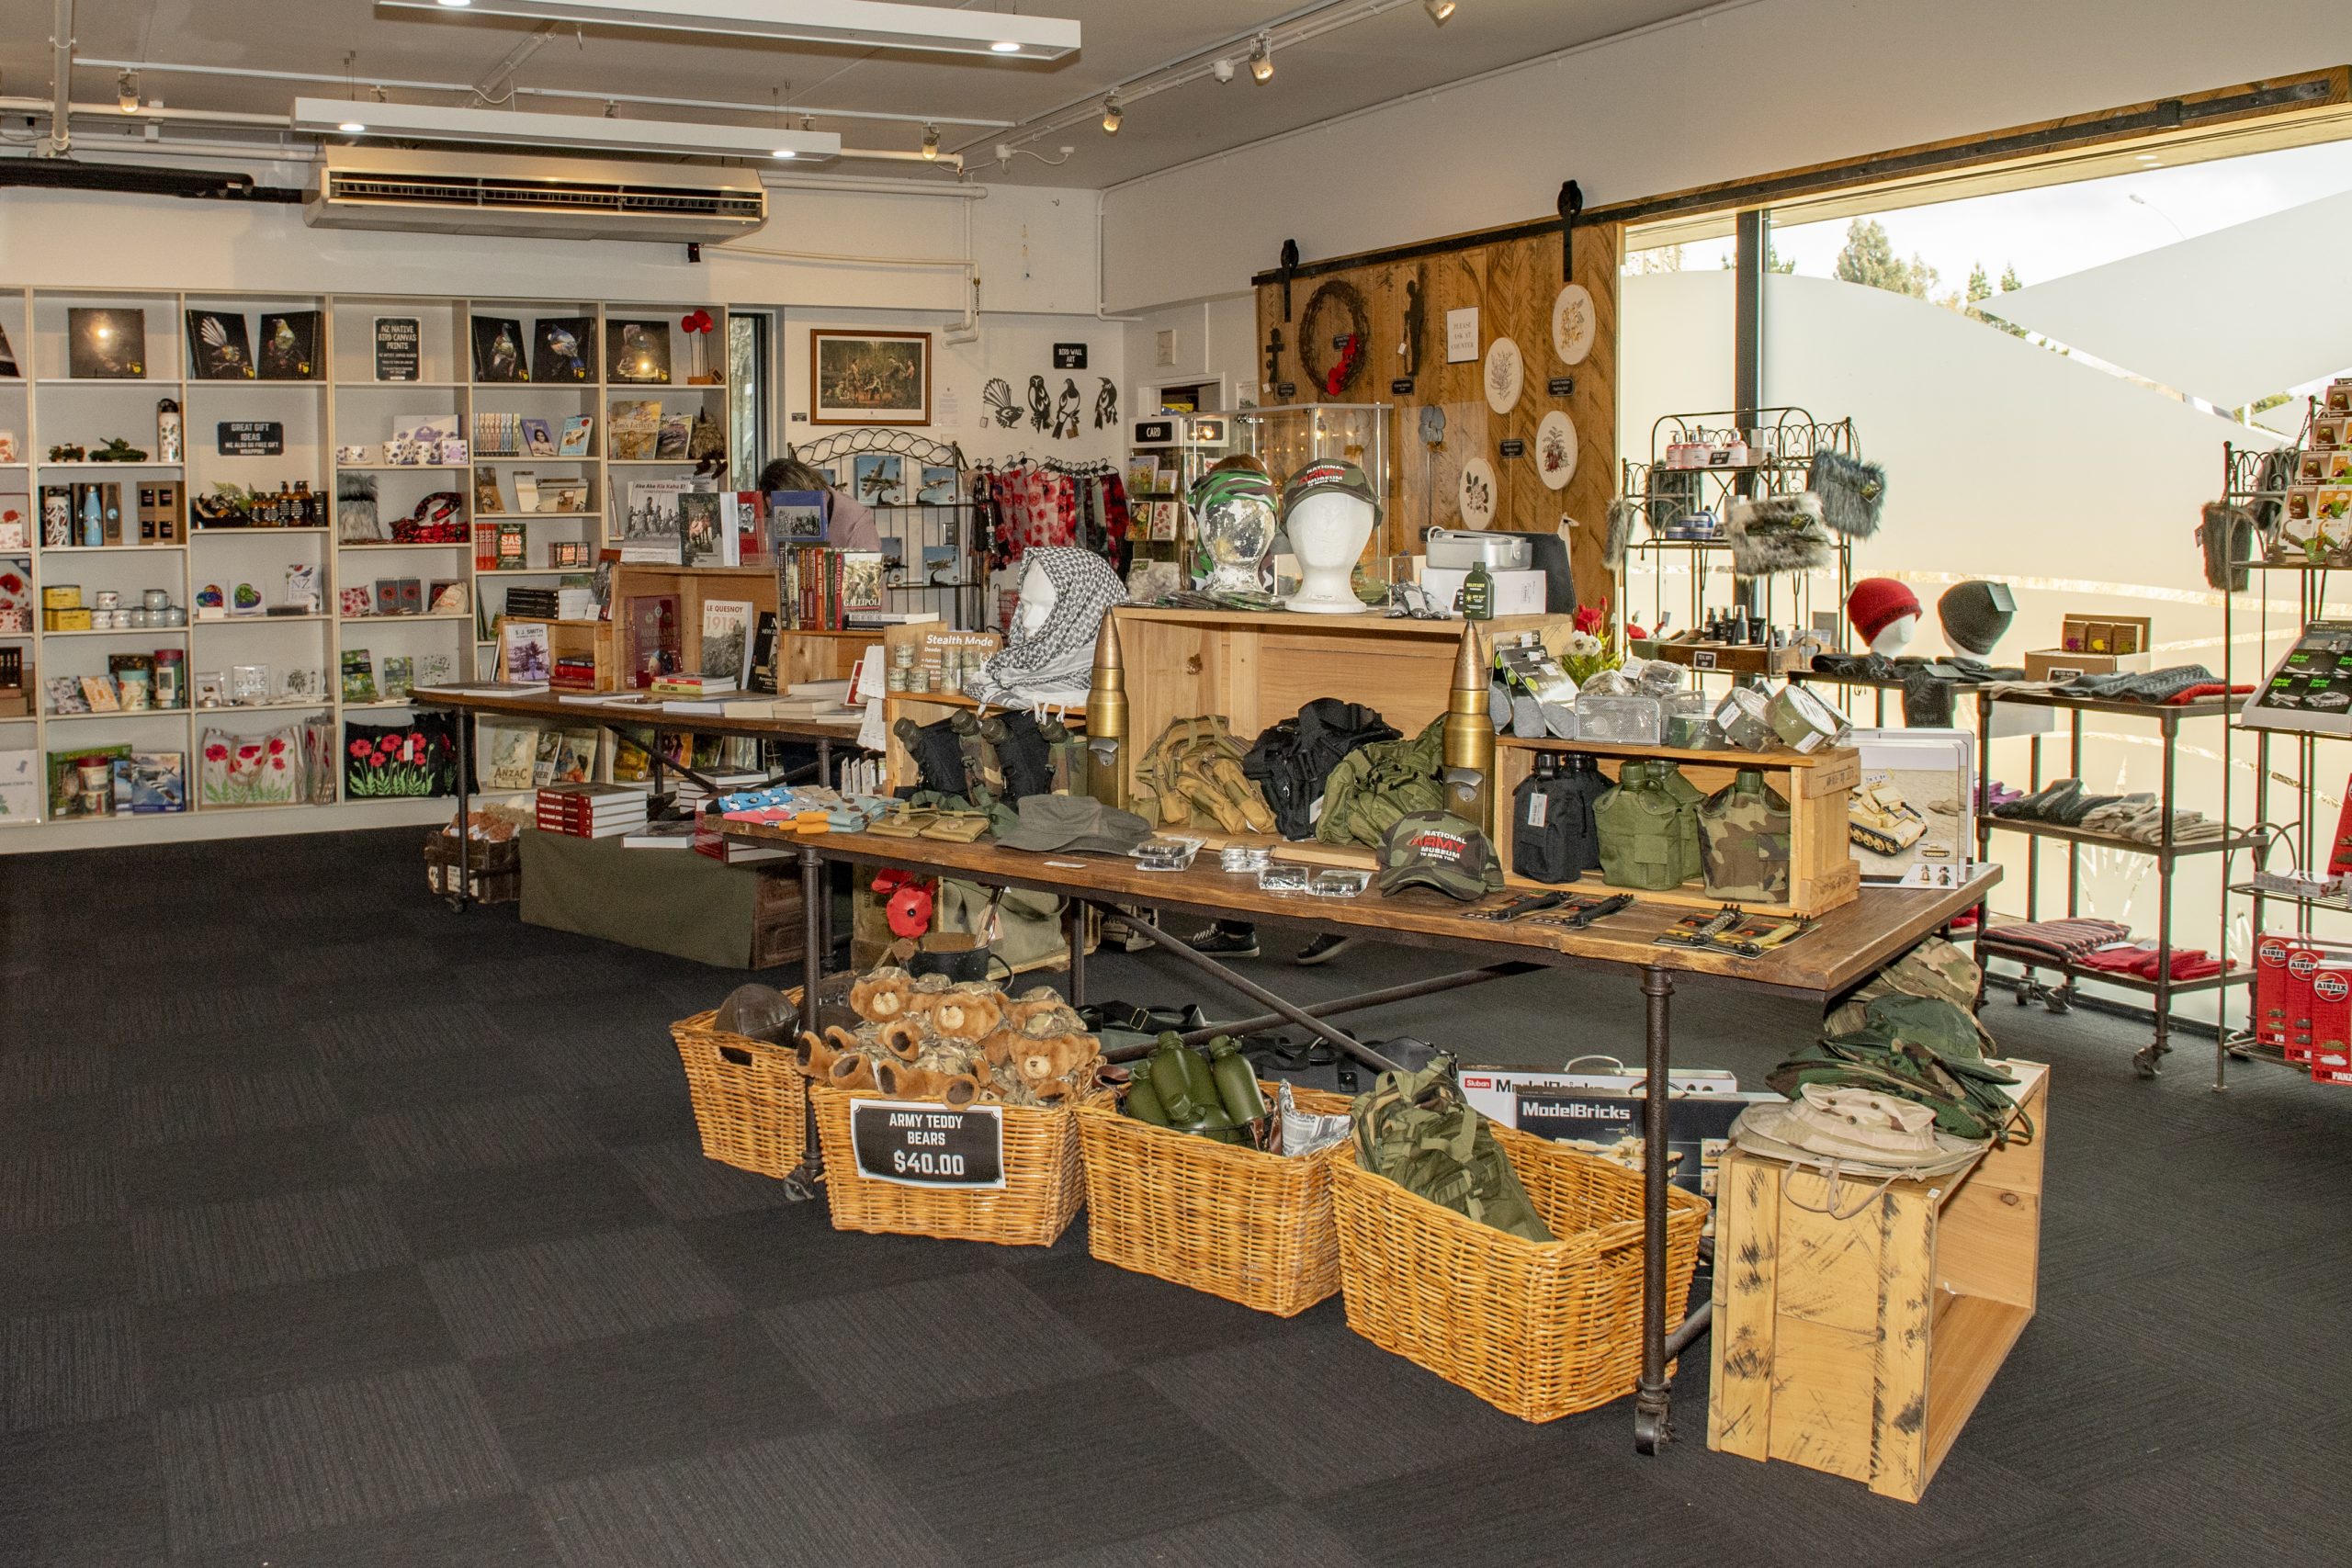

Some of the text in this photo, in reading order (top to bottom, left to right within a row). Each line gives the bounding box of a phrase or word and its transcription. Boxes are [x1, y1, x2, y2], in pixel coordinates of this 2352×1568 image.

[391, 325, 413, 333] NATIVE
[1453, 321, 1471, 330] PLEASE
[241, 433, 261, 441] IDEAS
[1146, 427, 1161, 437] CARD
[1306, 465, 1346, 474] NATIONAL
[1296, 468, 1346, 486] ARMY
[1307, 476, 1343, 484] MUSEUM
[501, 535, 522, 546] SAS
[843, 598, 881, 606] GALLIPOLI
[714, 605, 743, 614] QUESNOY
[706, 616, 736, 632] 1918
[926, 634, 994, 647] Stealth Mode
[494, 767, 527, 780] ANZAC
[1424, 829, 1467, 844] NATIONAL
[1408, 835, 1467, 853] ARMY
[1420, 846, 1461, 859] MUSEUM
[2261, 949, 2286, 957] AIRFI
[2290, 962, 2313, 970] AIRFI
[2316, 983, 2347, 992] AIRFIX
[1466, 1079, 1490, 1088] Sluban
[1522, 1101, 1631, 1120] ModelBricks
[889, 1112, 964, 1129] ARMY TEDDY
[907, 1131, 946, 1145] BEARS
[894, 1149, 965, 1176] $40.00
